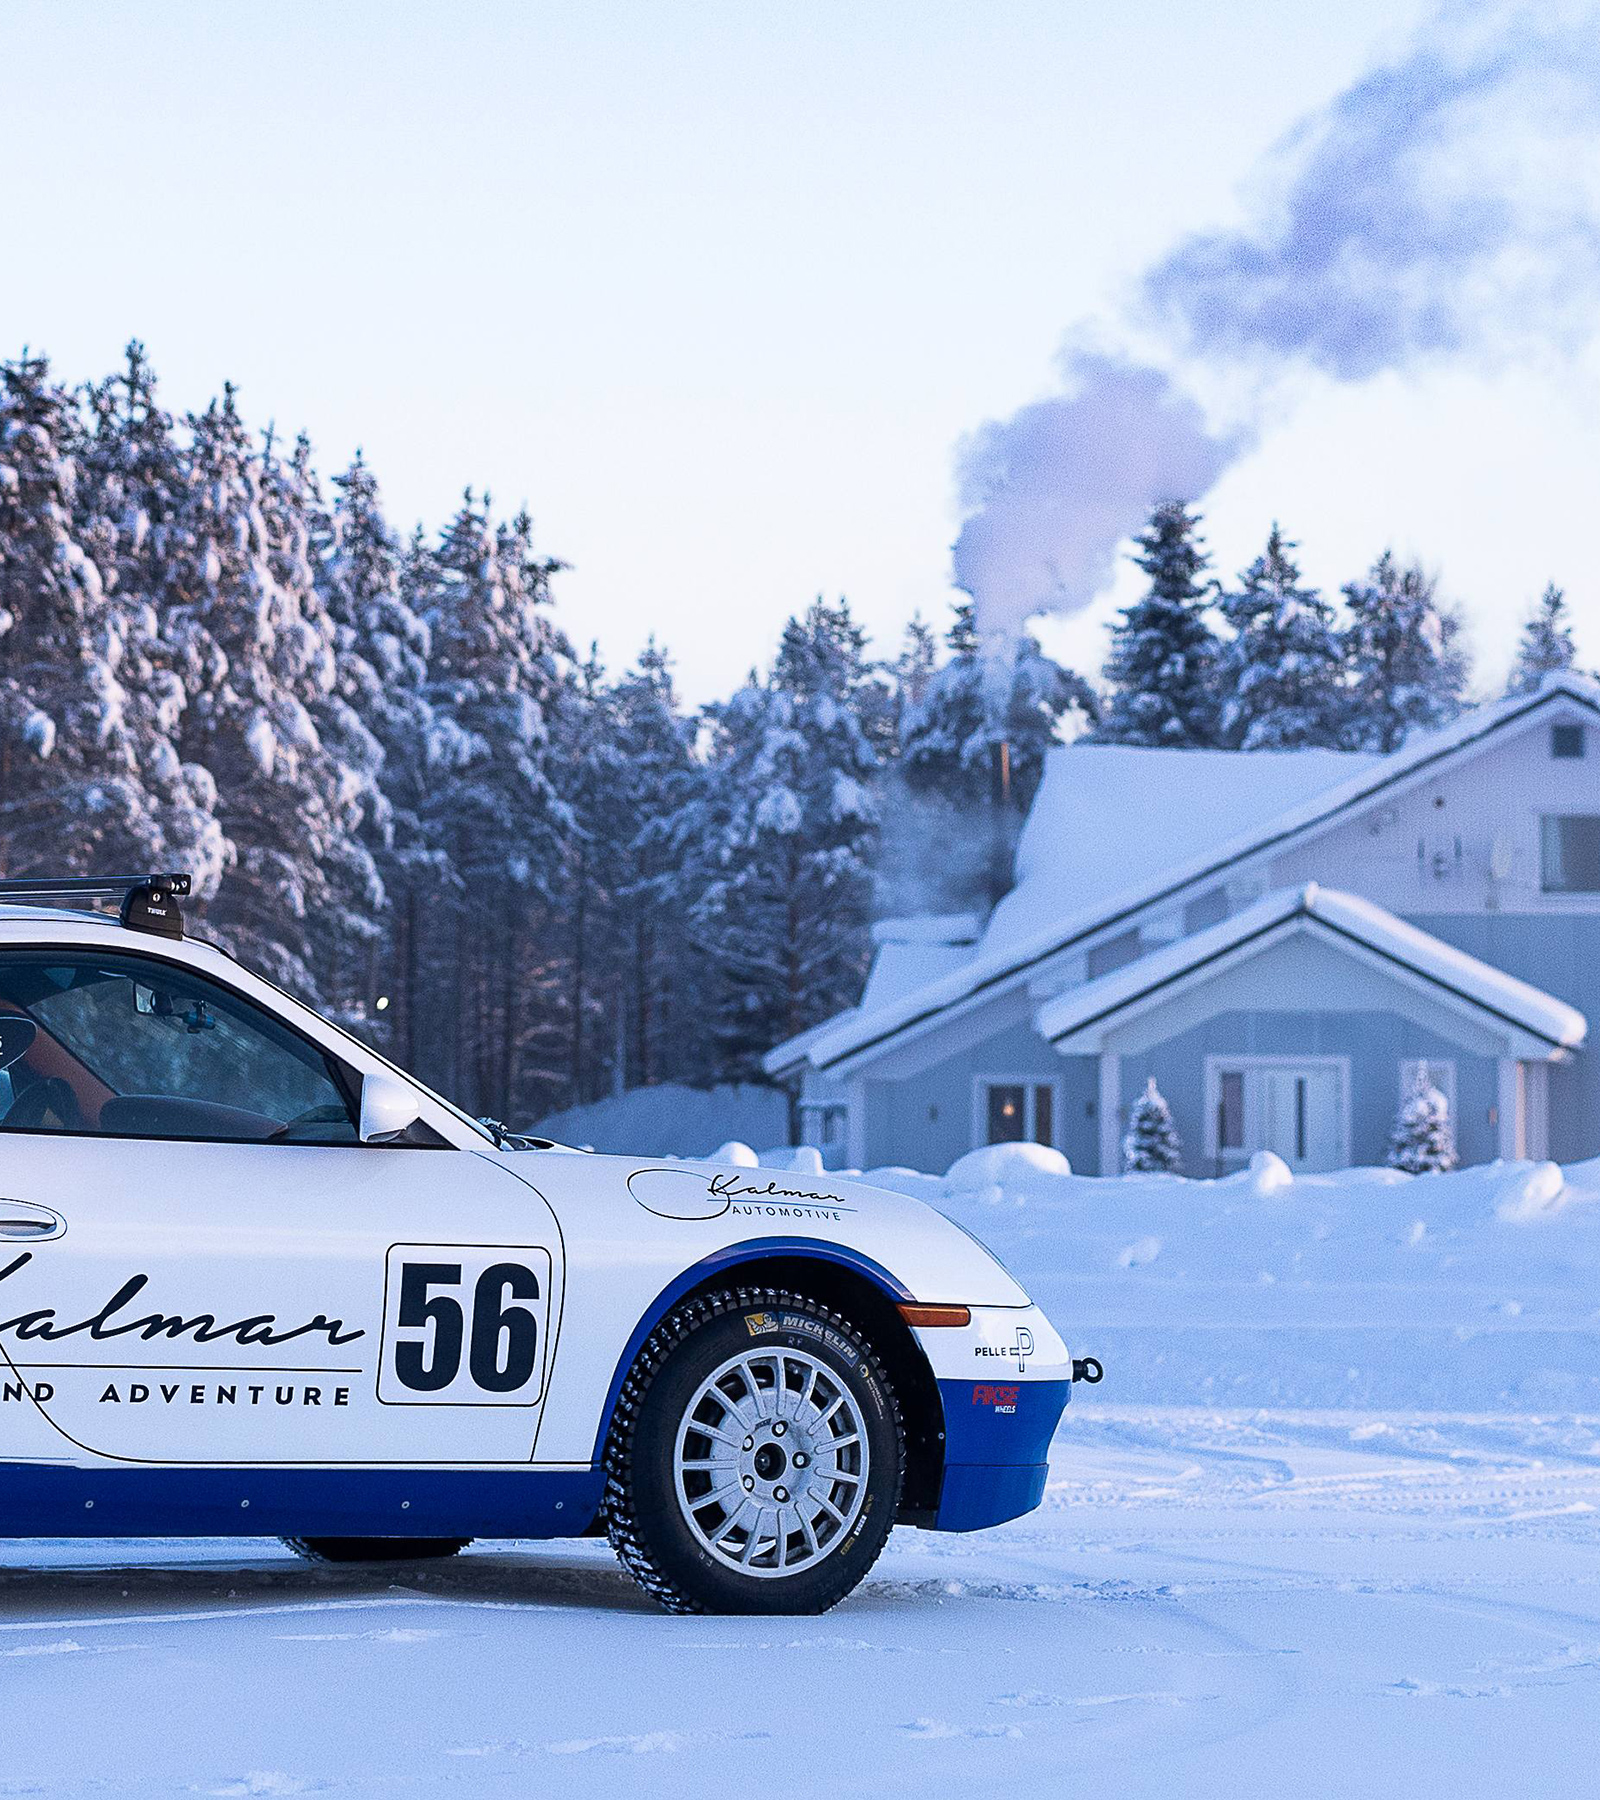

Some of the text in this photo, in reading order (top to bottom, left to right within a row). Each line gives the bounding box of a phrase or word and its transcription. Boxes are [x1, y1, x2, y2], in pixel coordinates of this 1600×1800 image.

[706, 1174, 846, 1202] Kalmar
[731, 1206, 842, 1222] AUTOMOTIVE
[393, 1261, 541, 1393] 56
[782, 1315, 857, 1360] MICHELIN
[974, 1346, 1007, 1357] PELLE
[98, 1382, 351, 1407] ADVENTURE
